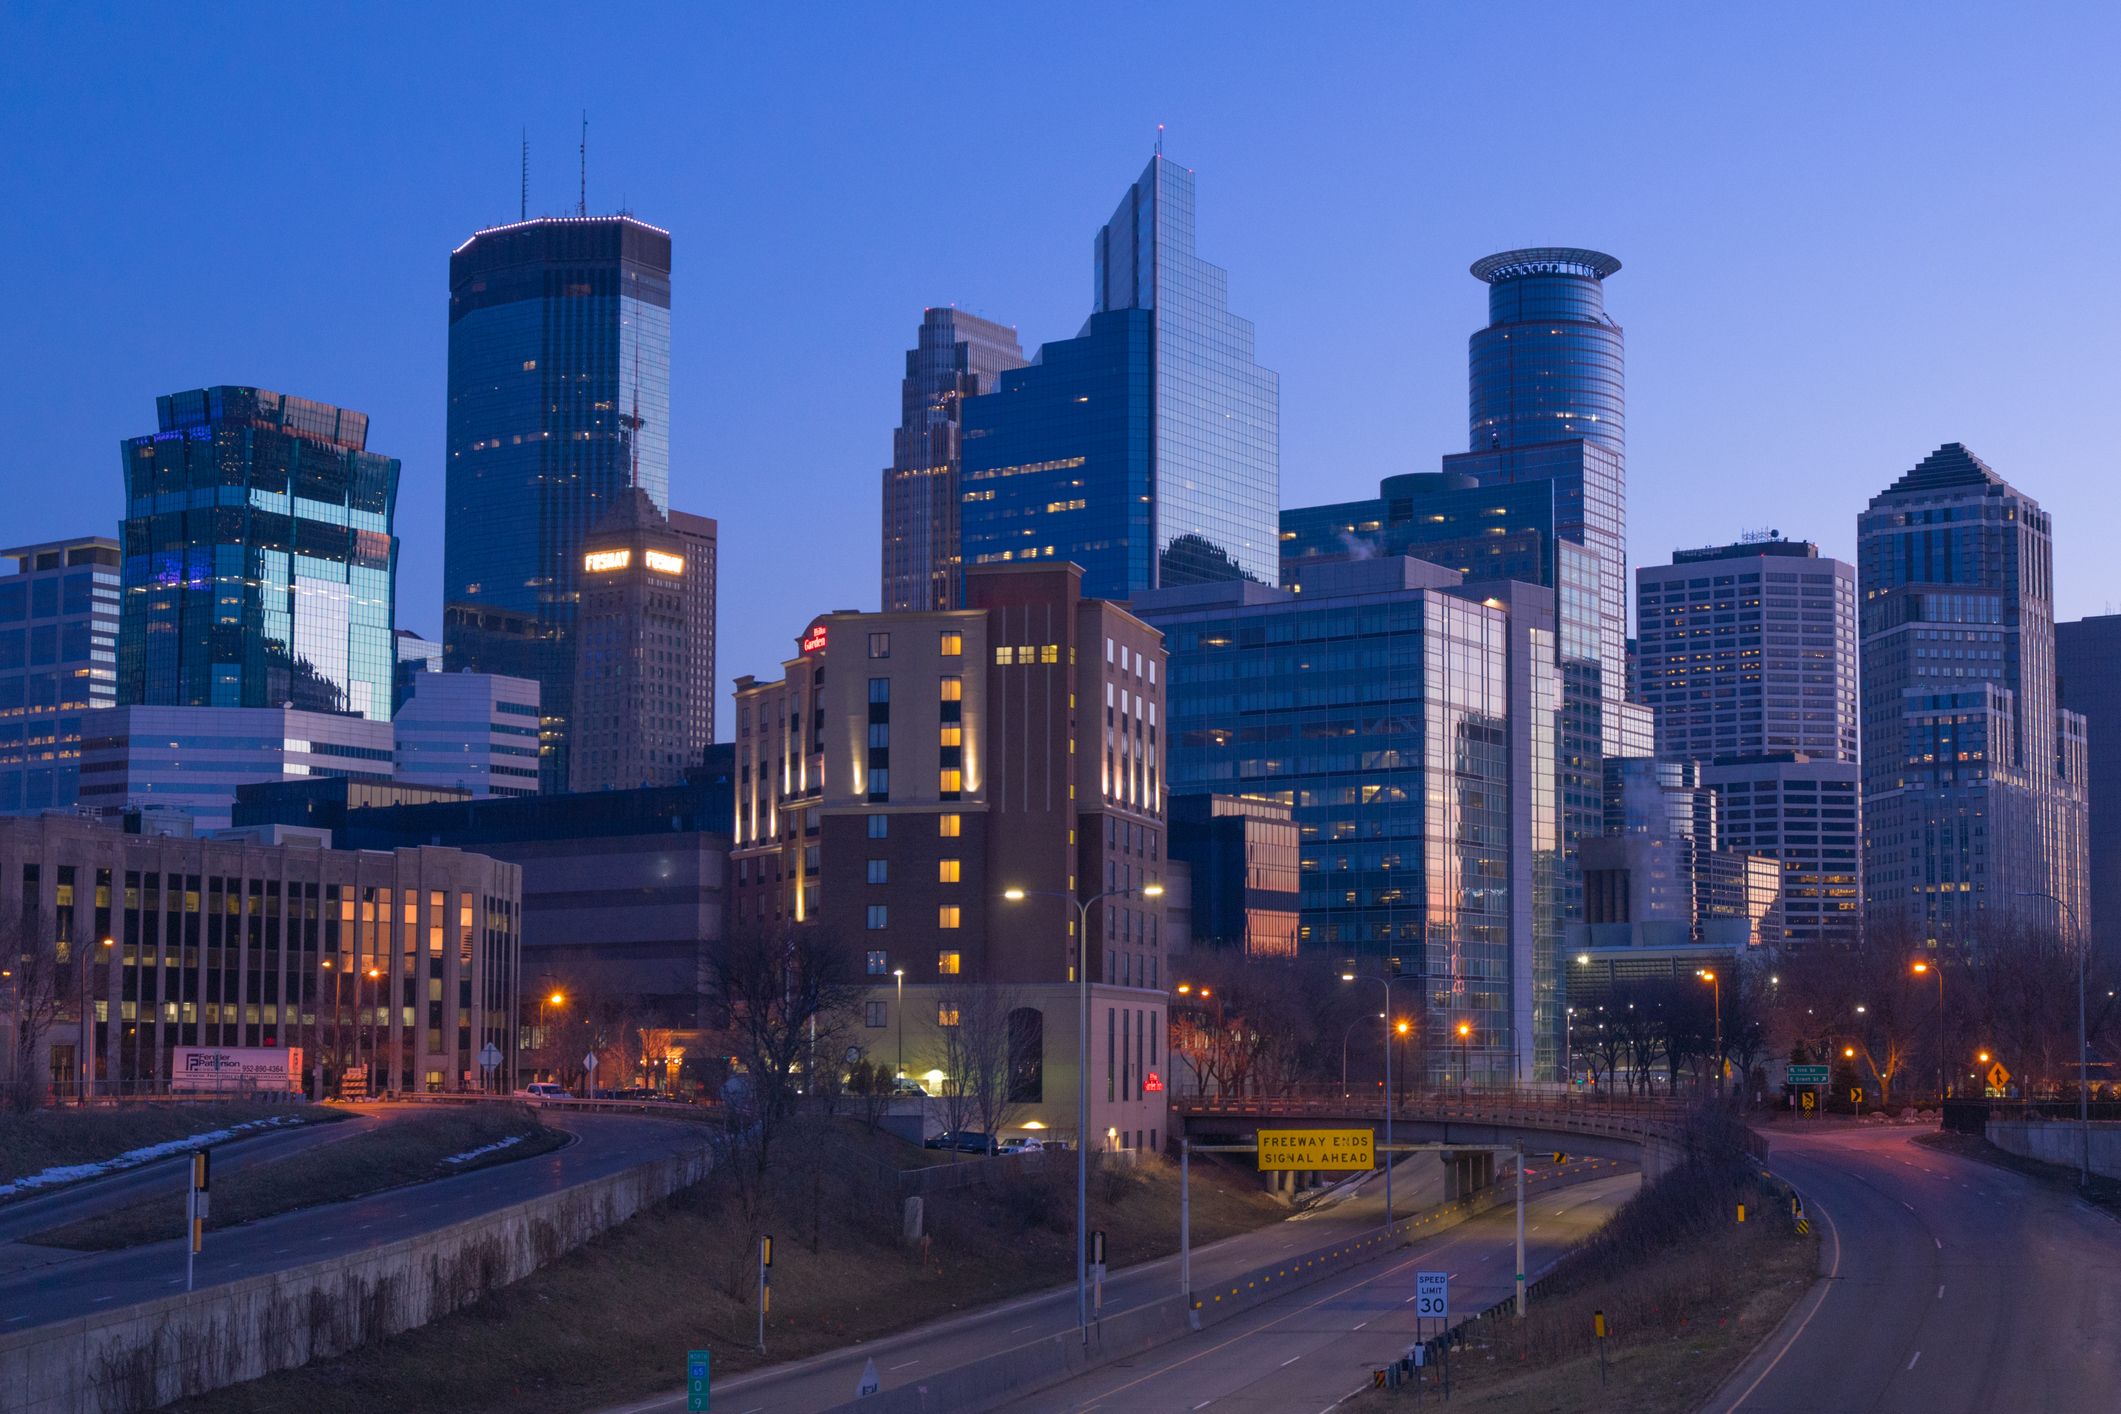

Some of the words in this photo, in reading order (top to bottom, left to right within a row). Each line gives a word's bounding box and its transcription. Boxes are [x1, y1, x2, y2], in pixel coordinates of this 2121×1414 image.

[1263, 1137, 1326, 1147] FREEWAY
[1333, 1136, 1368, 1147] ENDS
[1265, 1153, 1314, 1163] SIGNAL
[1321, 1152, 1368, 1163] AHEAD
[1419, 1276, 1446, 1284] SPEED
[1421, 1287, 1443, 1295] LIMIT
[1420, 1298, 1444, 1313] 30
